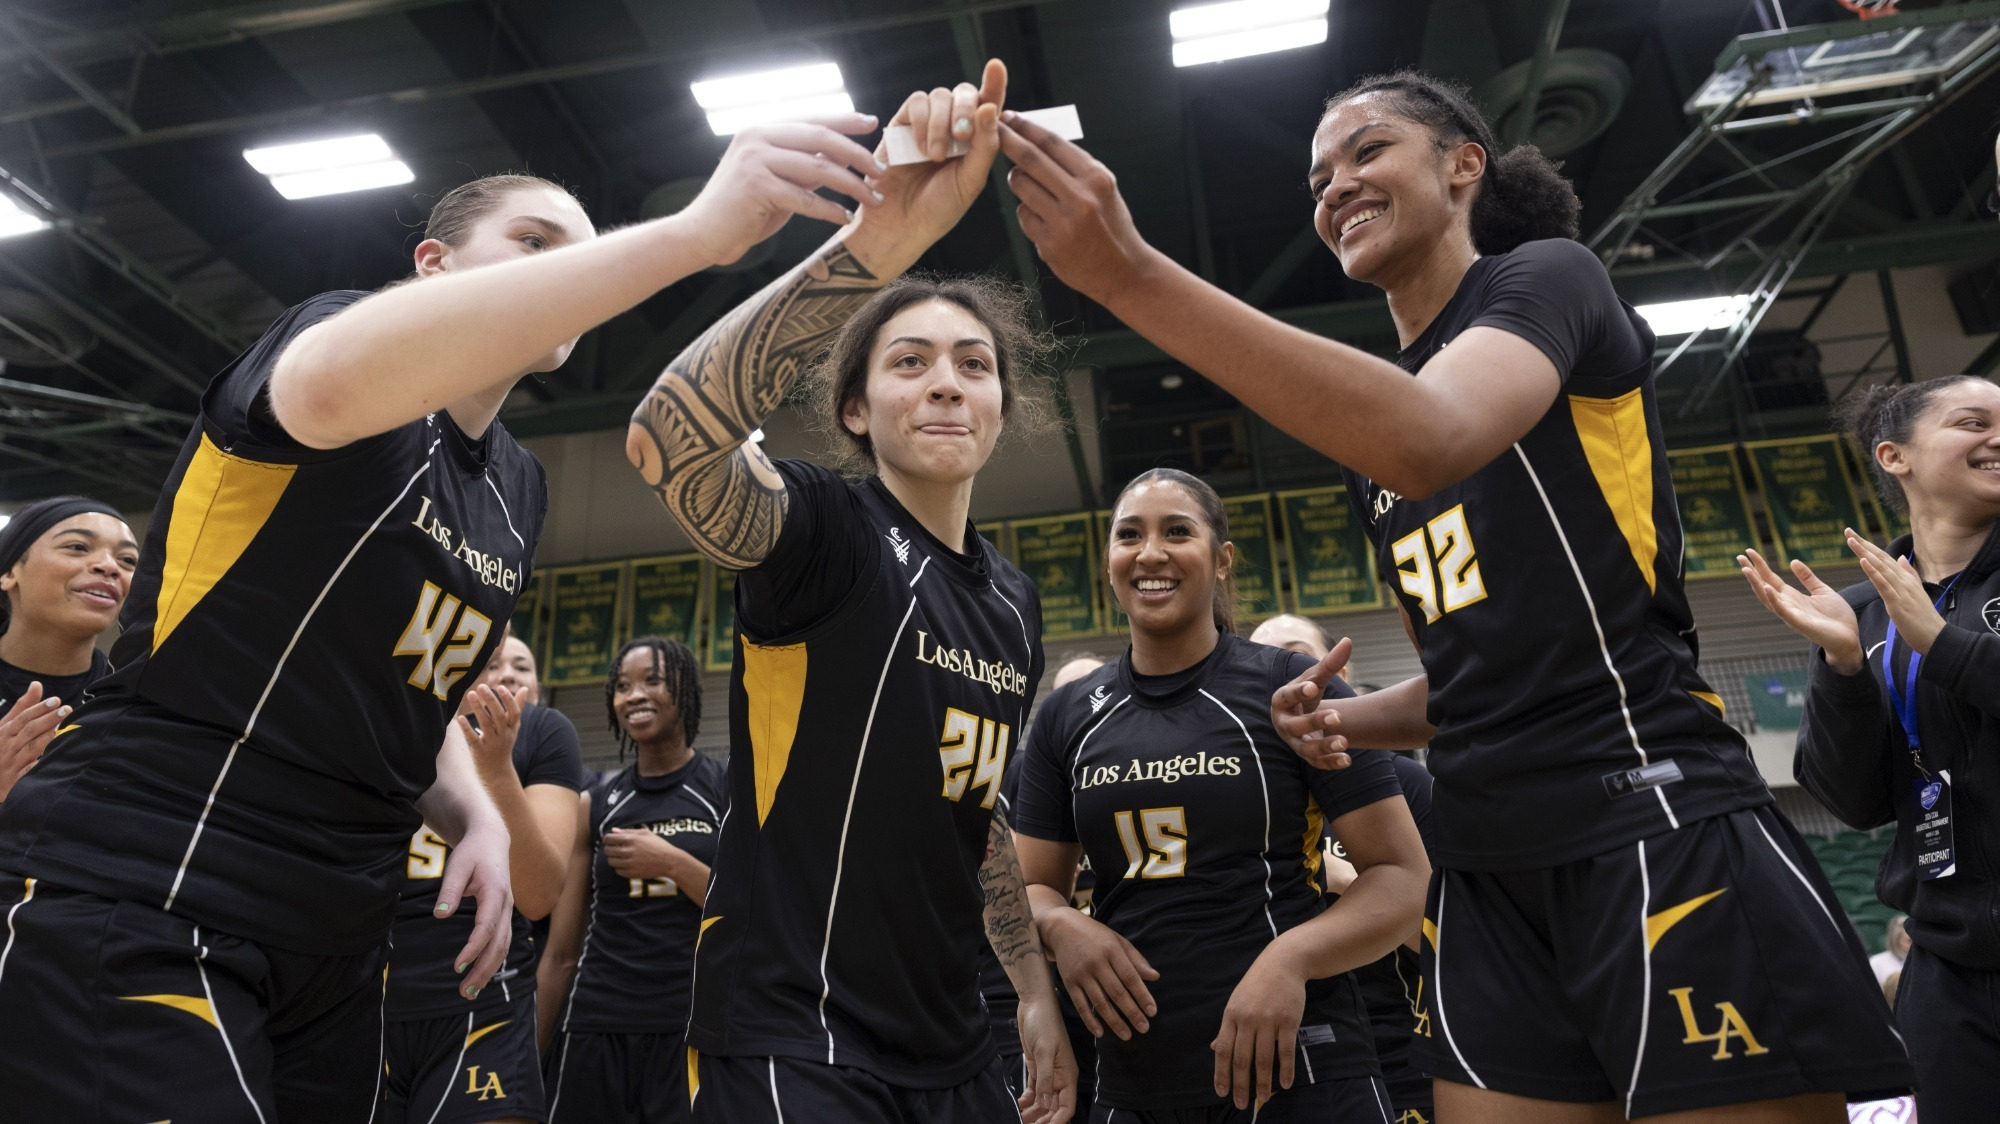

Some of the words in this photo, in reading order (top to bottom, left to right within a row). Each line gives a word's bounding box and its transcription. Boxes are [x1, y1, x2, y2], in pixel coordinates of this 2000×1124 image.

[411, 495, 452, 551] Los
[453, 538, 517, 595] Angeles
[1392, 504, 1488, 625] 92
[392, 579, 493, 701] 42
[916, 630, 961, 672] Los
[963, 649, 1028, 696] Angeles
[939, 707, 1010, 810] 24
[1080, 765, 1121, 790] Los
[1121, 751, 1242, 784] Angeles
[1114, 806, 1188, 879] 15
[1918, 848, 1950, 866] PARTICIPANT
[1668, 986, 1769, 1060] LA
[465, 1065, 507, 1101] LA
